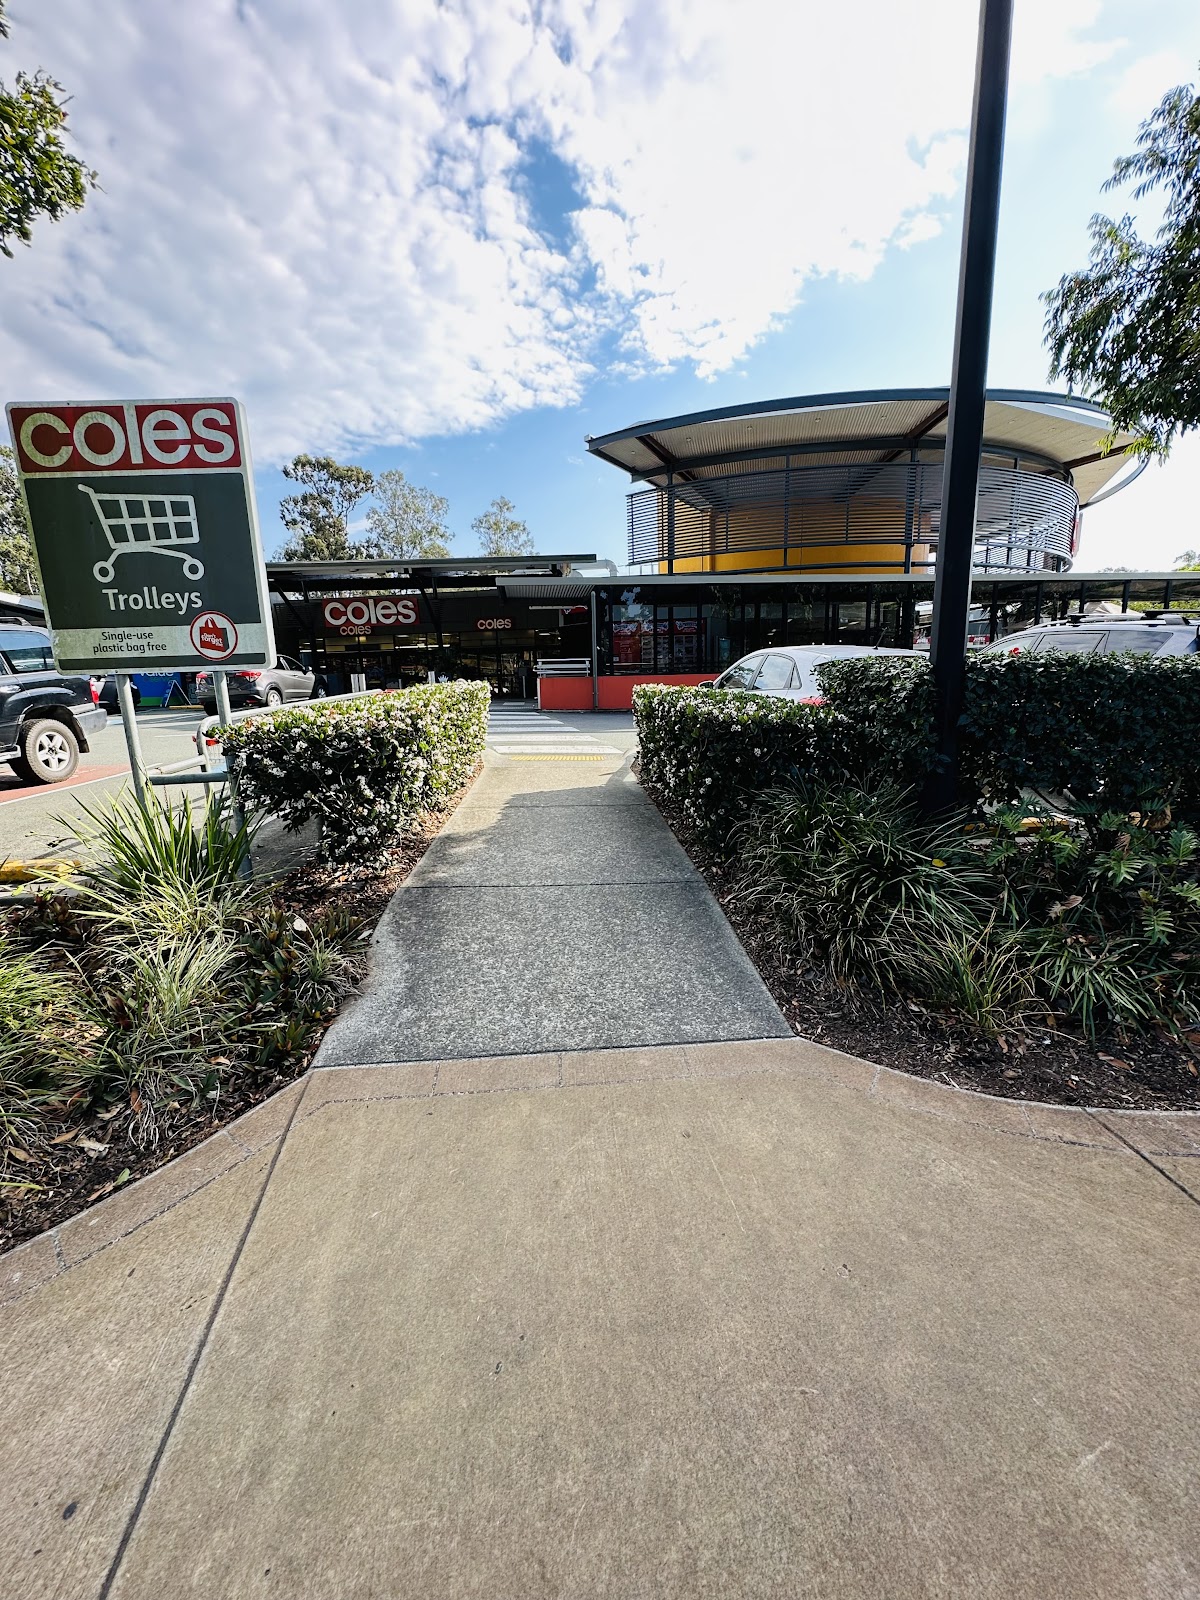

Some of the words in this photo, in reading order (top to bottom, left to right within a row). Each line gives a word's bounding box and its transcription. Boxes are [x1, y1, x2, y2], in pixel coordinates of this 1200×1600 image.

[19, 404, 236, 468] coles
[102, 586, 203, 615] Trolleys
[324, 598, 417, 626] coles
[340, 625, 372, 636] coles
[477, 618, 512, 630] coles
[101, 630, 154, 643] Single-use
[201, 634, 223, 645] forget
[92, 643, 125, 655] plastic
[127, 642, 145, 654] bag
[147, 641, 167, 651] free
